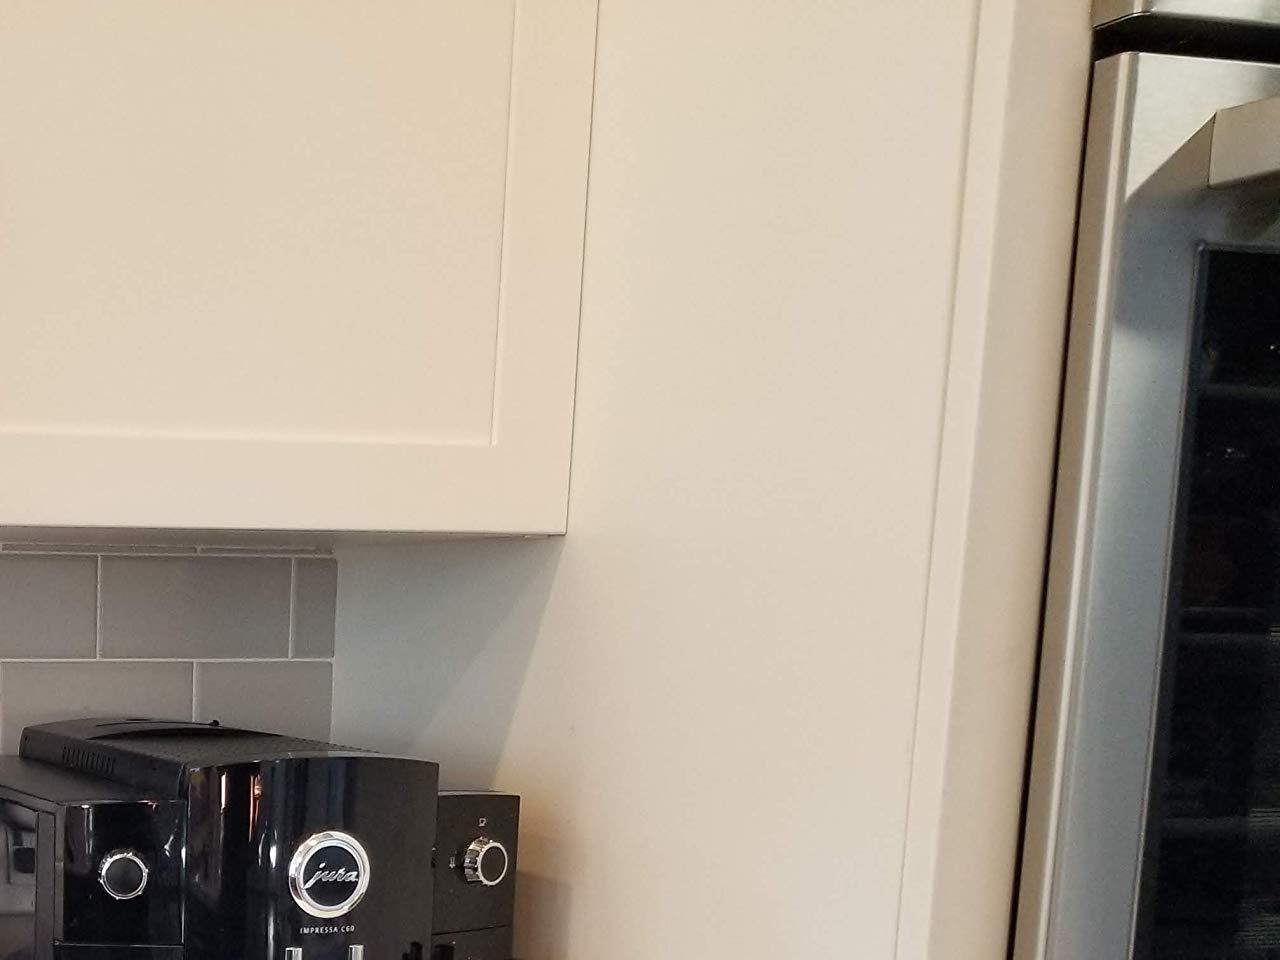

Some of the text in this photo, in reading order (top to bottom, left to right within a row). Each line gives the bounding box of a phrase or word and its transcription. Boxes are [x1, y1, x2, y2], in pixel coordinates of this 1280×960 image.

[303, 862, 360, 890] jura
[299, 925, 356, 935] IMPRESSA C60
